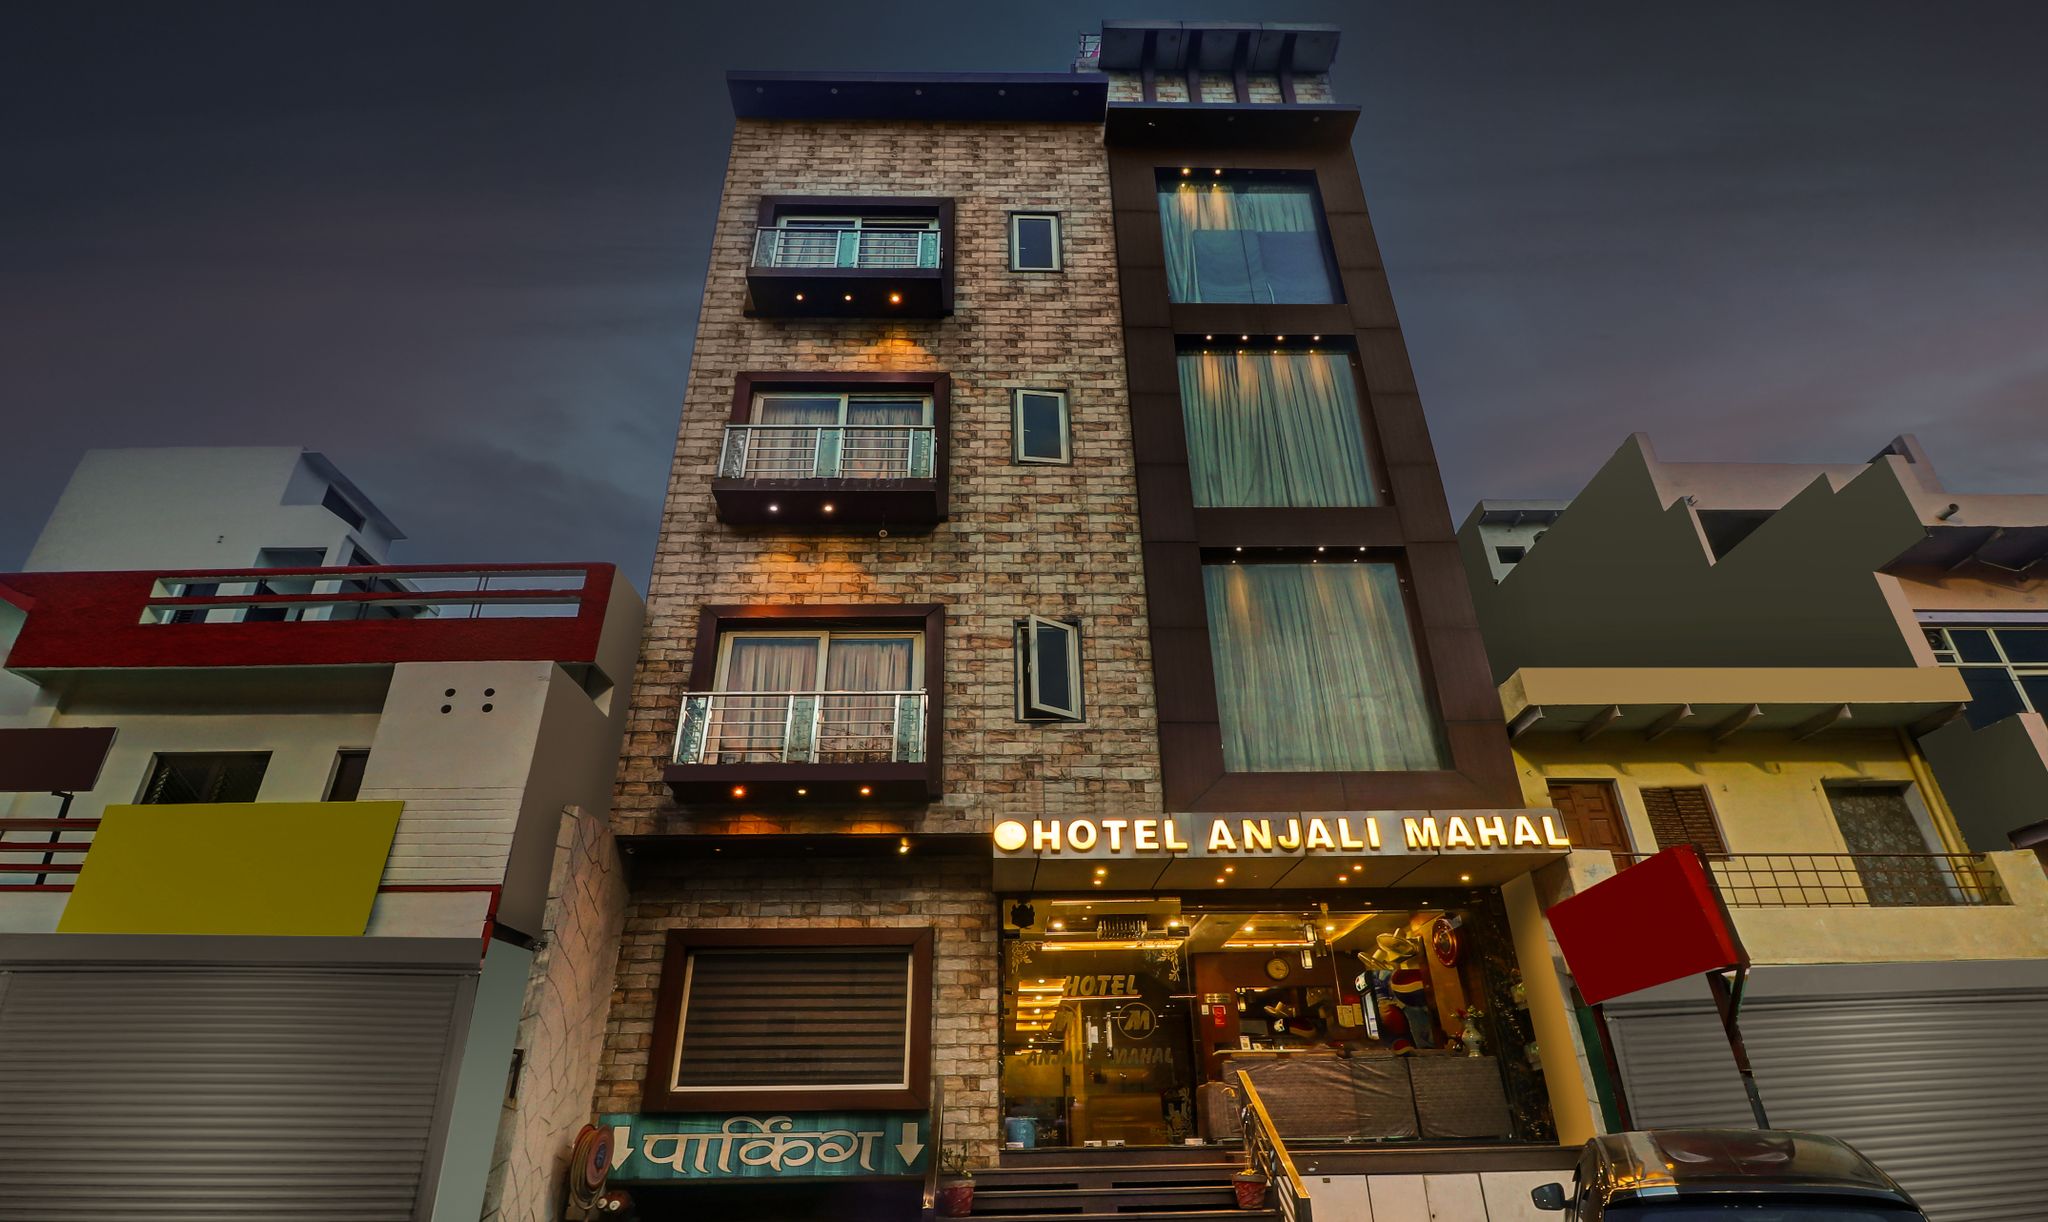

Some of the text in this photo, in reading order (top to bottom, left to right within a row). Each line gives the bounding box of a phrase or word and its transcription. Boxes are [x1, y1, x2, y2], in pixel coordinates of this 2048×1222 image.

[1032, 815, 1570, 853] HOTEL ANJALI MAHAL
[1062, 975, 1139, 996] HOTEL
[1026, 1050, 1086, 1067] ANJAL
[642, 1116, 884, 1174] पार्किंग
